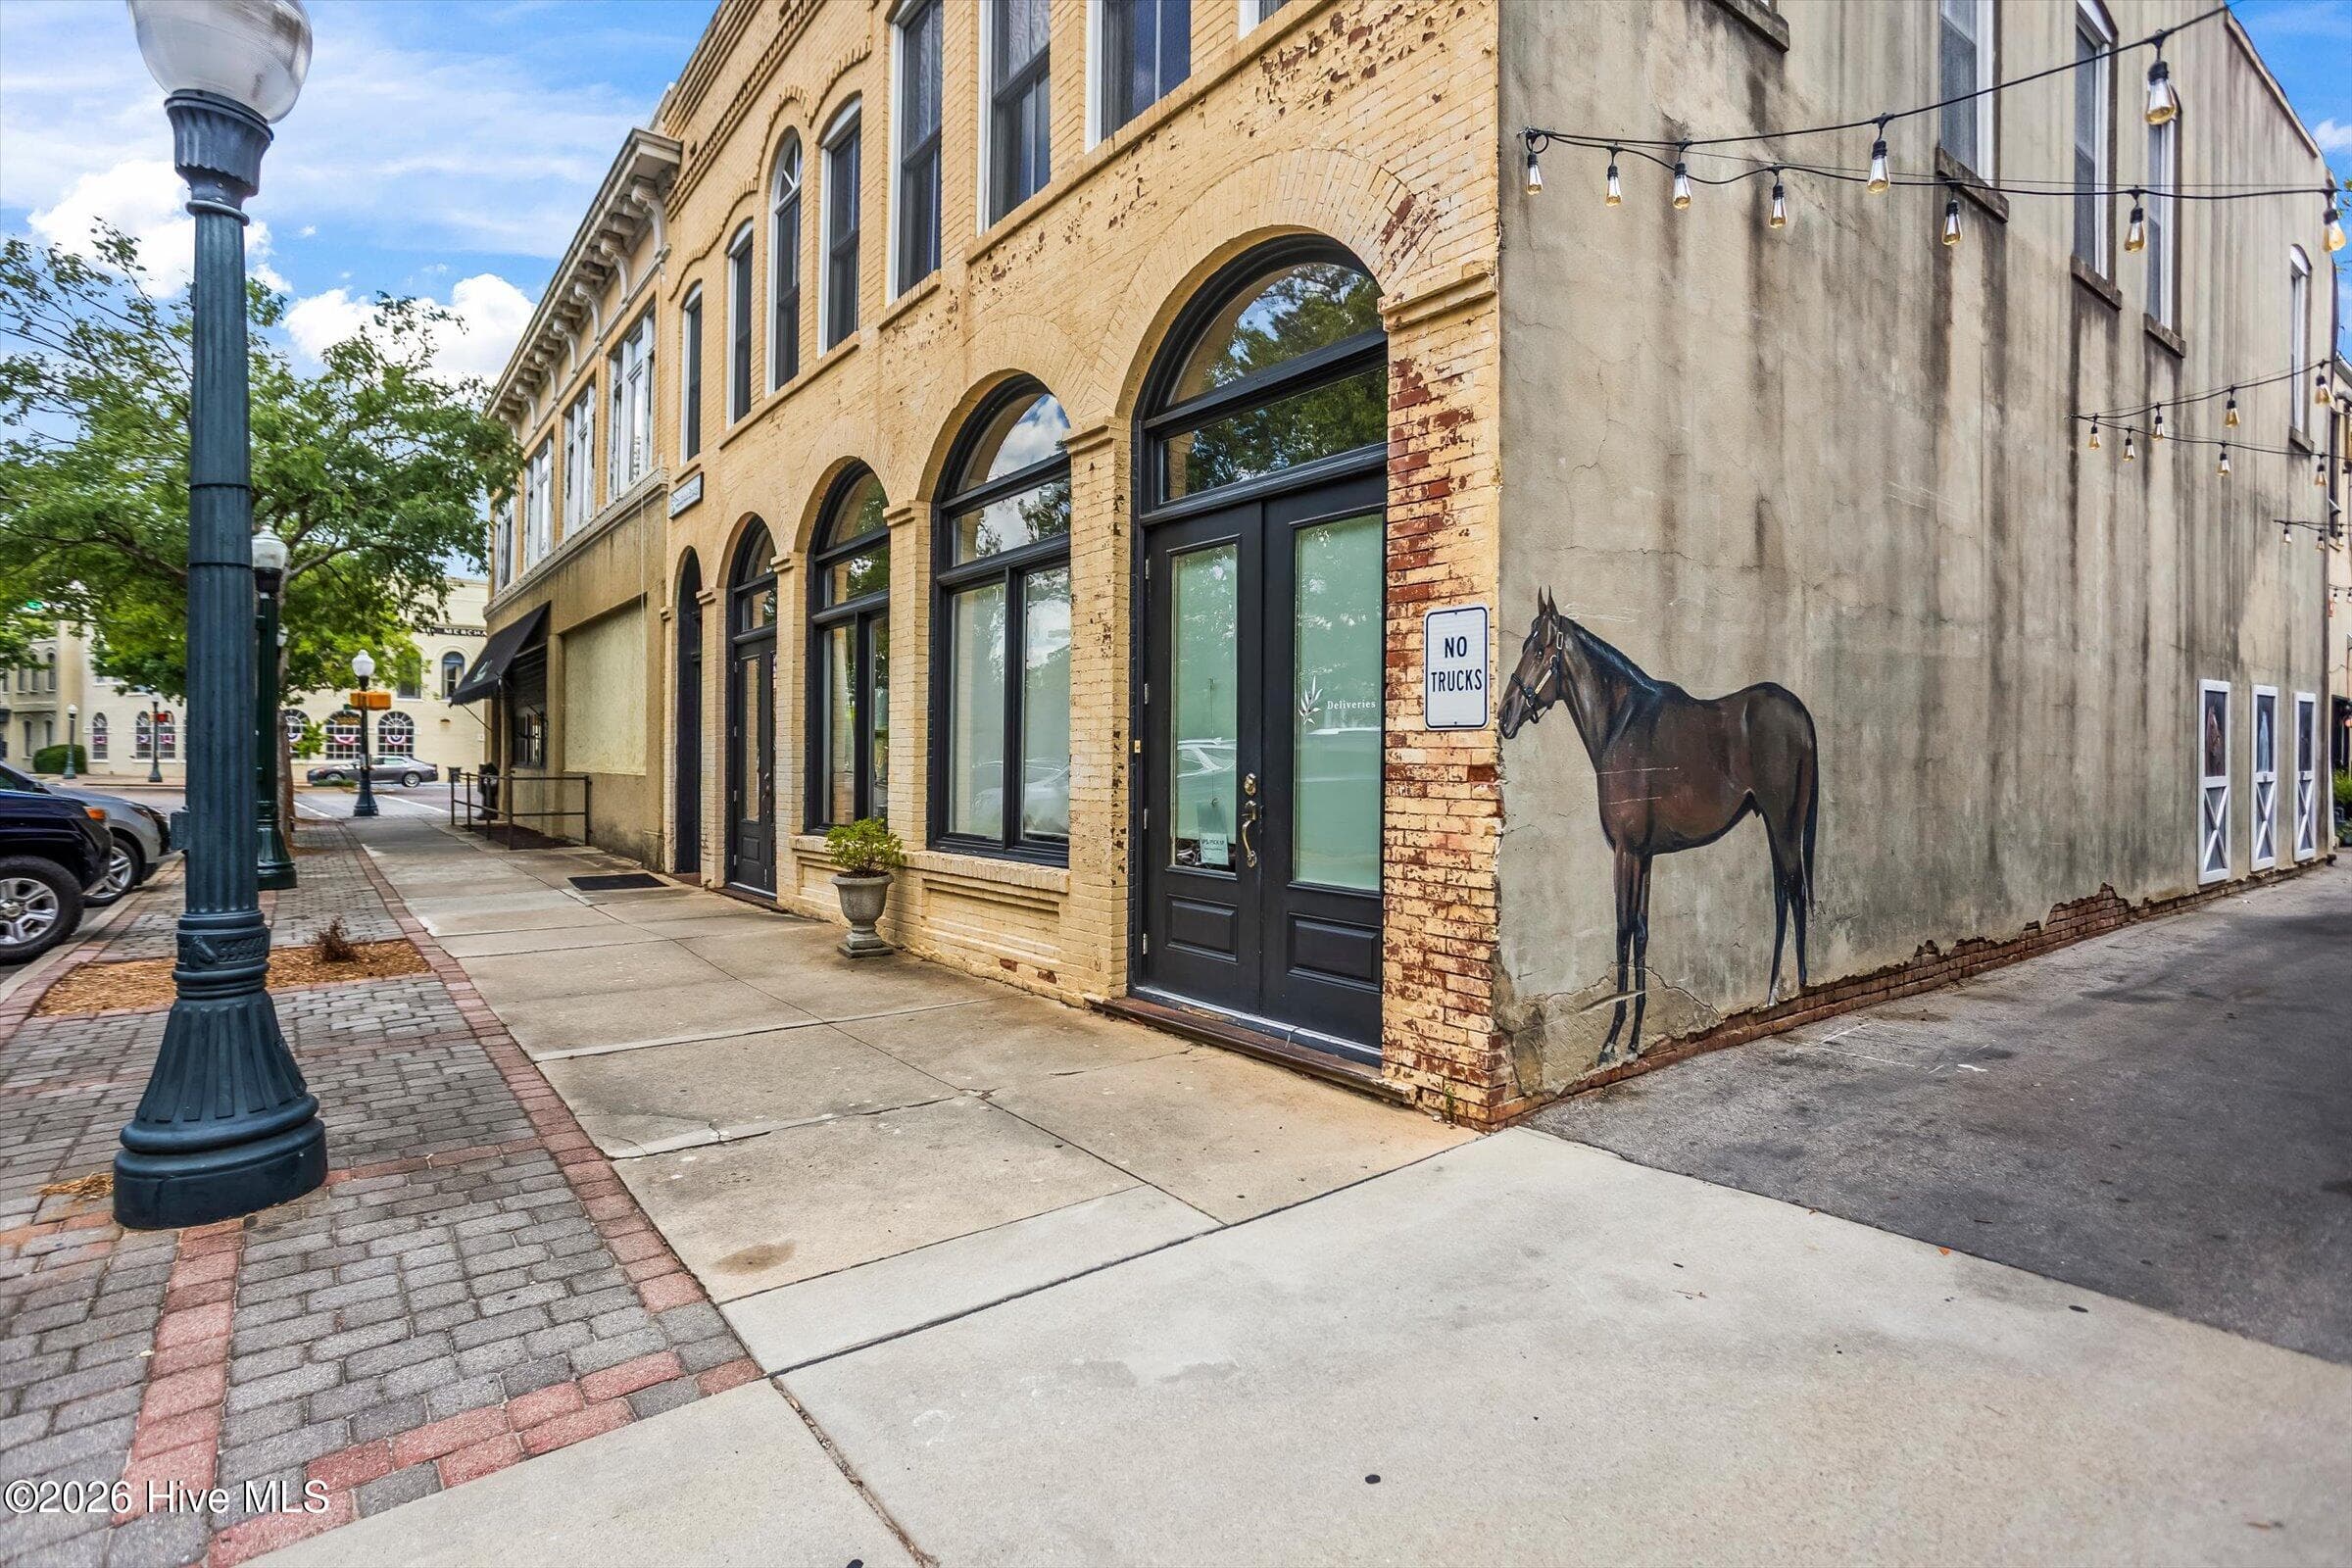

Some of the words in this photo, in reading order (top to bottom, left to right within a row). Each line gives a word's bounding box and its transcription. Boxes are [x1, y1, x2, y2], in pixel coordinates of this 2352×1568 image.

[1445, 636, 1468, 659] NO
[1431, 668, 1483, 693] TRUCKS
[1327, 699, 1376, 710] Deliveries
